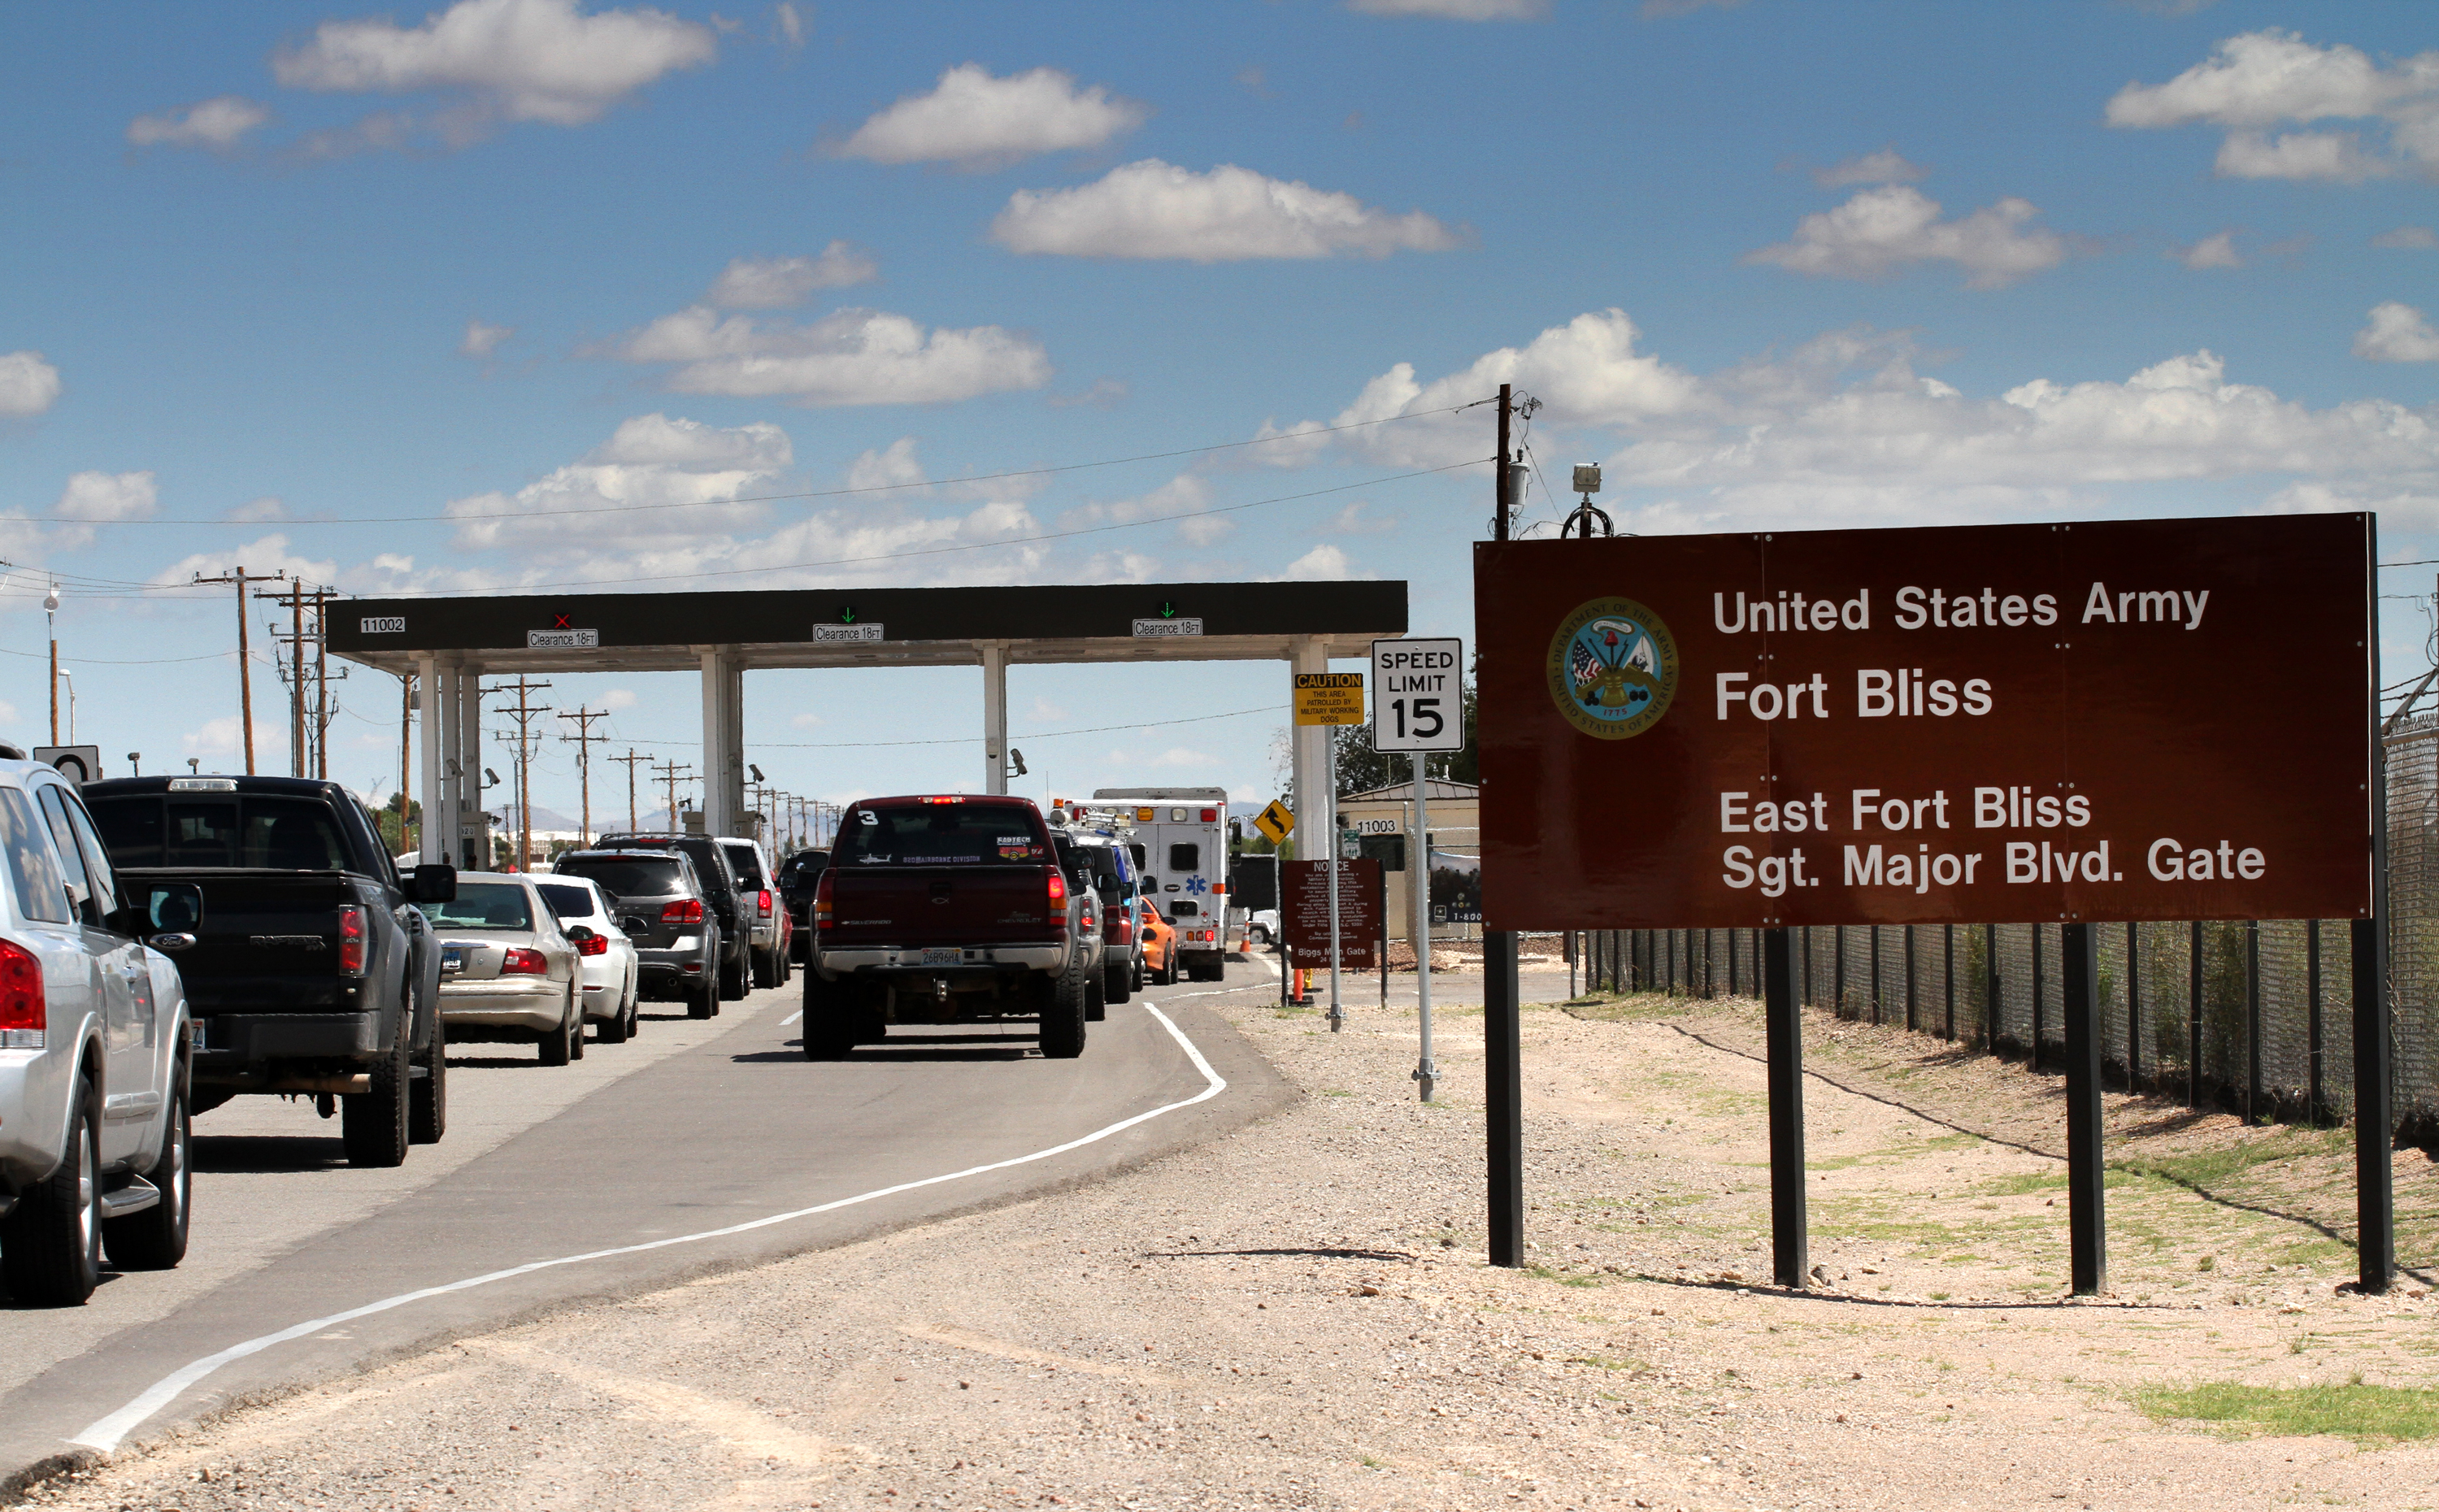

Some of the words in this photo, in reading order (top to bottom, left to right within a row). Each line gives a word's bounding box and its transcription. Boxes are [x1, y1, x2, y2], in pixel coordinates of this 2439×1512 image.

[1714, 589, 1869, 634] United
[1894, 585, 2058, 630] States
[2081, 582, 2210, 630] Army
[363, 619, 403, 632] 11002
[1135, 622, 1178, 634] Clearance
[1180, 621, 1199, 633] 18FT
[1554, 604, 1606, 663] DEPARTMENT
[1613, 603, 1628, 613] OF
[1633, 608, 1654, 627] THE
[1654, 629, 1673, 661] ARMY
[530, 632, 573, 646] Clearance
[576, 632, 594, 645] 18FT
[816, 627, 859, 640] Clearance
[862, 627, 880, 639] 18FT
[1380, 652, 1454, 669] SPEED
[1297, 674, 1361, 688] CAUTION
[1388, 675, 1446, 692] LIMIT
[1554, 674, 1579, 717] UNITED
[1580, 716, 1624, 733] STATES
[1628, 719, 1643, 731] OF
[1644, 671, 1673, 723] AMERICA
[1716, 671, 1828, 721] Fort
[1858, 668, 1993, 718] Bliss
[1392, 698, 1444, 738] 15
[1603, 708, 1628, 716] 1775
[1720, 791, 1828, 834] East
[1852, 789, 1950, 831] Fort
[1974, 786, 2091, 828] Bliss
[858, 810, 879, 826] 3
[1358, 820, 1395, 832] 11003
[1314, 861, 1350, 871] NOCE
[1722, 845, 1819, 897] Sgt.
[1844, 843, 1982, 895] Major
[2006, 840, 2123, 884] Blvd.
[2147, 837, 2266, 882] Gate
[163, 936, 182, 946] Ford
[1298, 948, 1321, 957] Biggs
[1324, 948, 1343, 956] Mn
